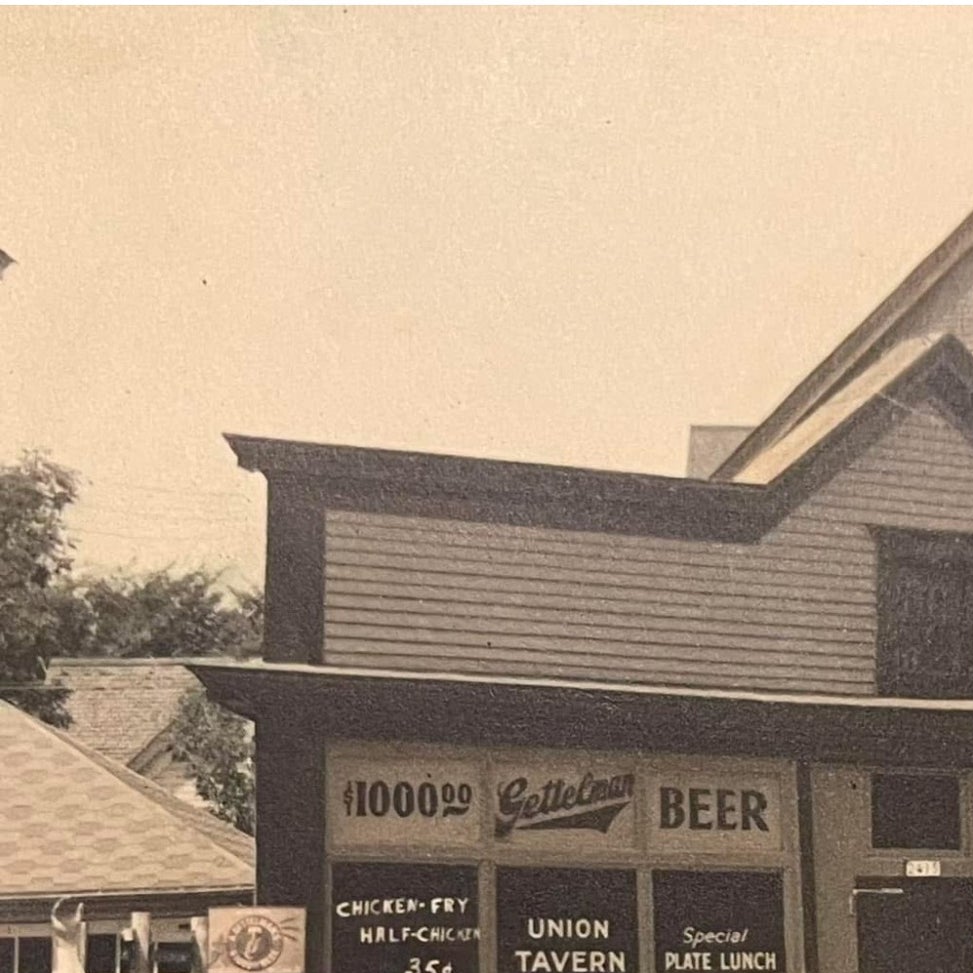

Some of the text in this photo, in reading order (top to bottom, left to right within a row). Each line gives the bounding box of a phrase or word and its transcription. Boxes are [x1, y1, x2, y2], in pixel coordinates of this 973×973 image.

[495, 772, 635, 838] Gettelman
[659, 787, 769, 832] BEER
[528, 918, 609, 939] UNION
[683, 926, 748, 948] Special
[515, 950, 626, 973] TAVERN
[665, 951, 776, 971] PLATE LUNCH
